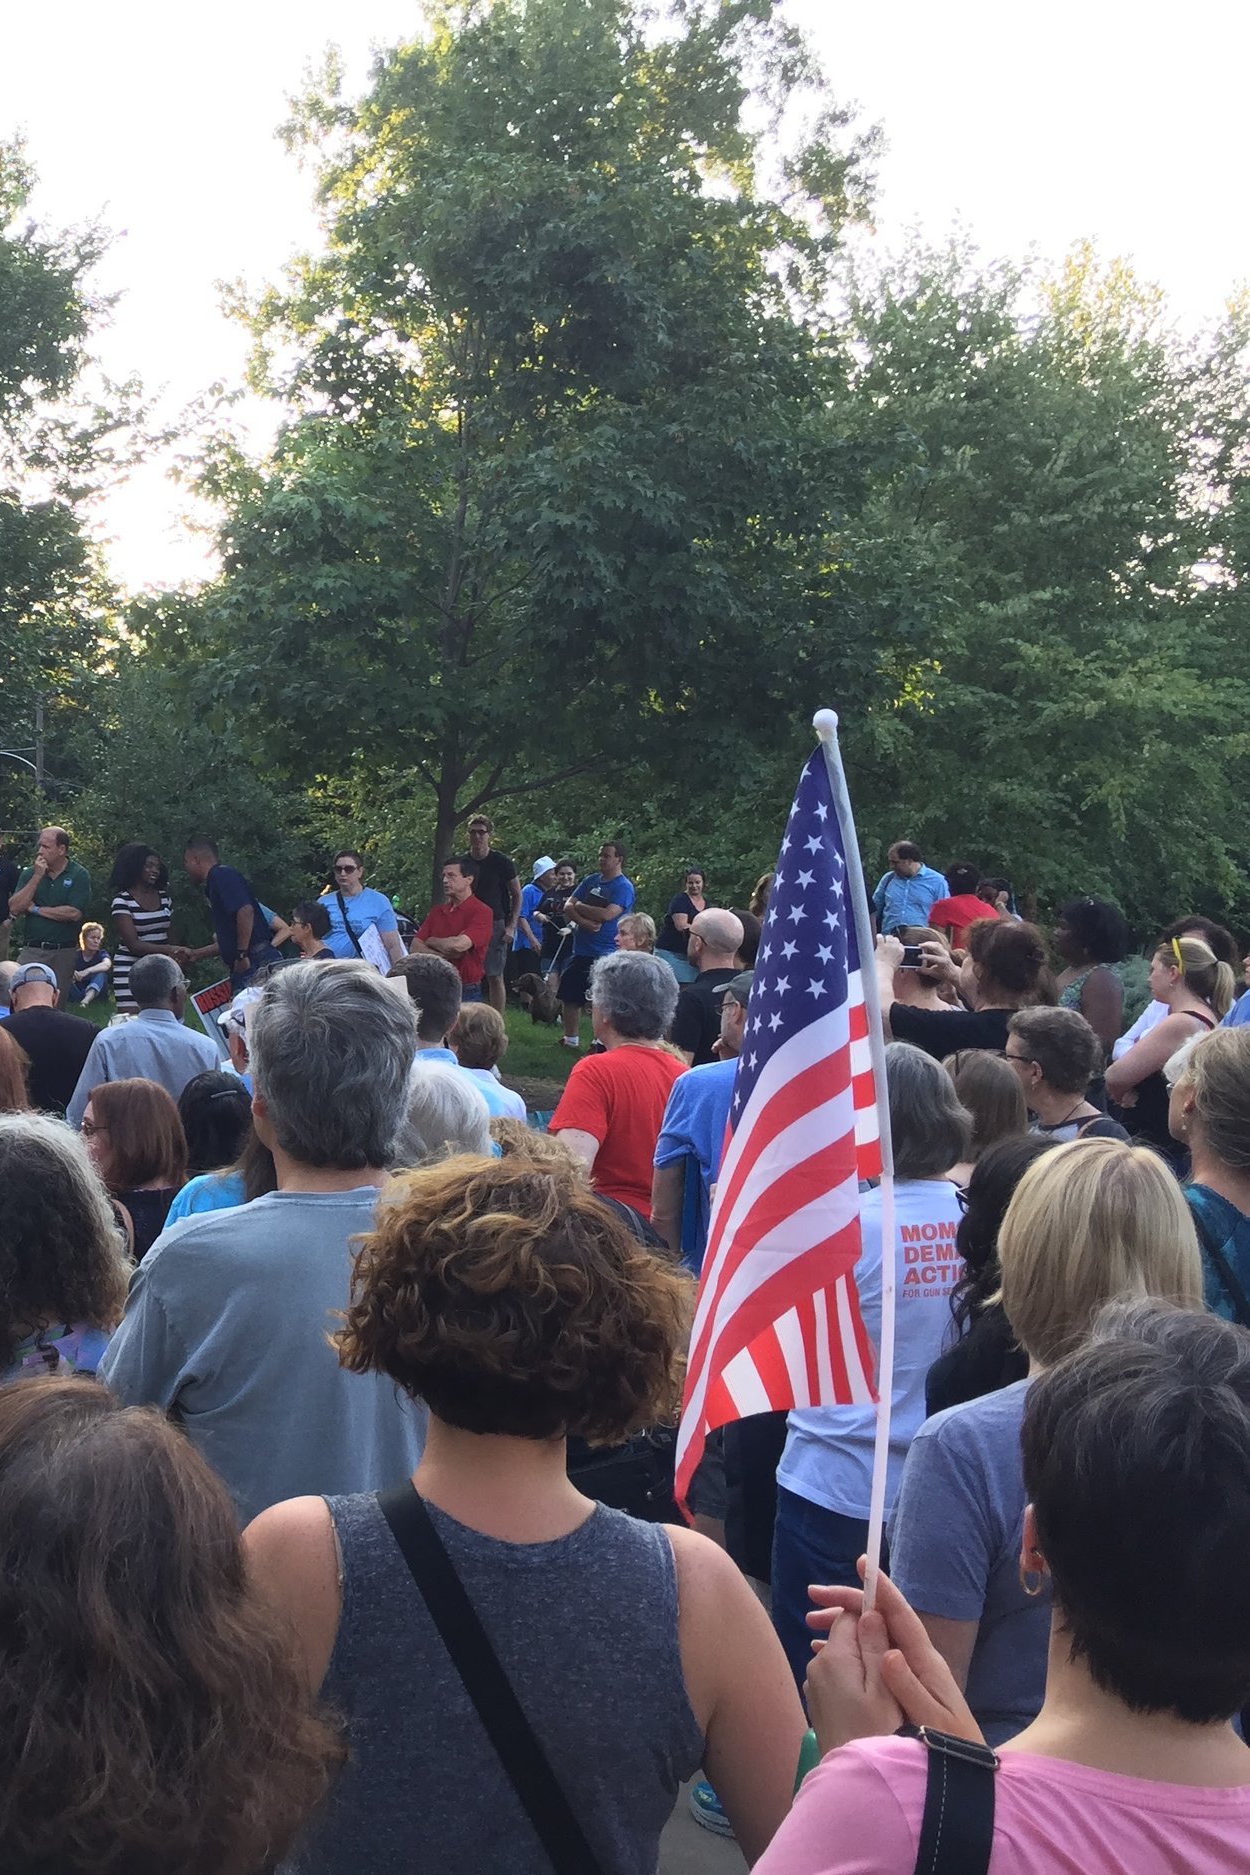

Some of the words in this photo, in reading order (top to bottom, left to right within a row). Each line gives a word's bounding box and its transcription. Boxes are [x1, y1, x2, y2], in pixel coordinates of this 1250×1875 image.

[900, 1221, 957, 1243] MOM
[904, 1243, 960, 1265] DEM
[903, 1289, 920, 1298] FOR
[923, 1287, 940, 1297] GUN
